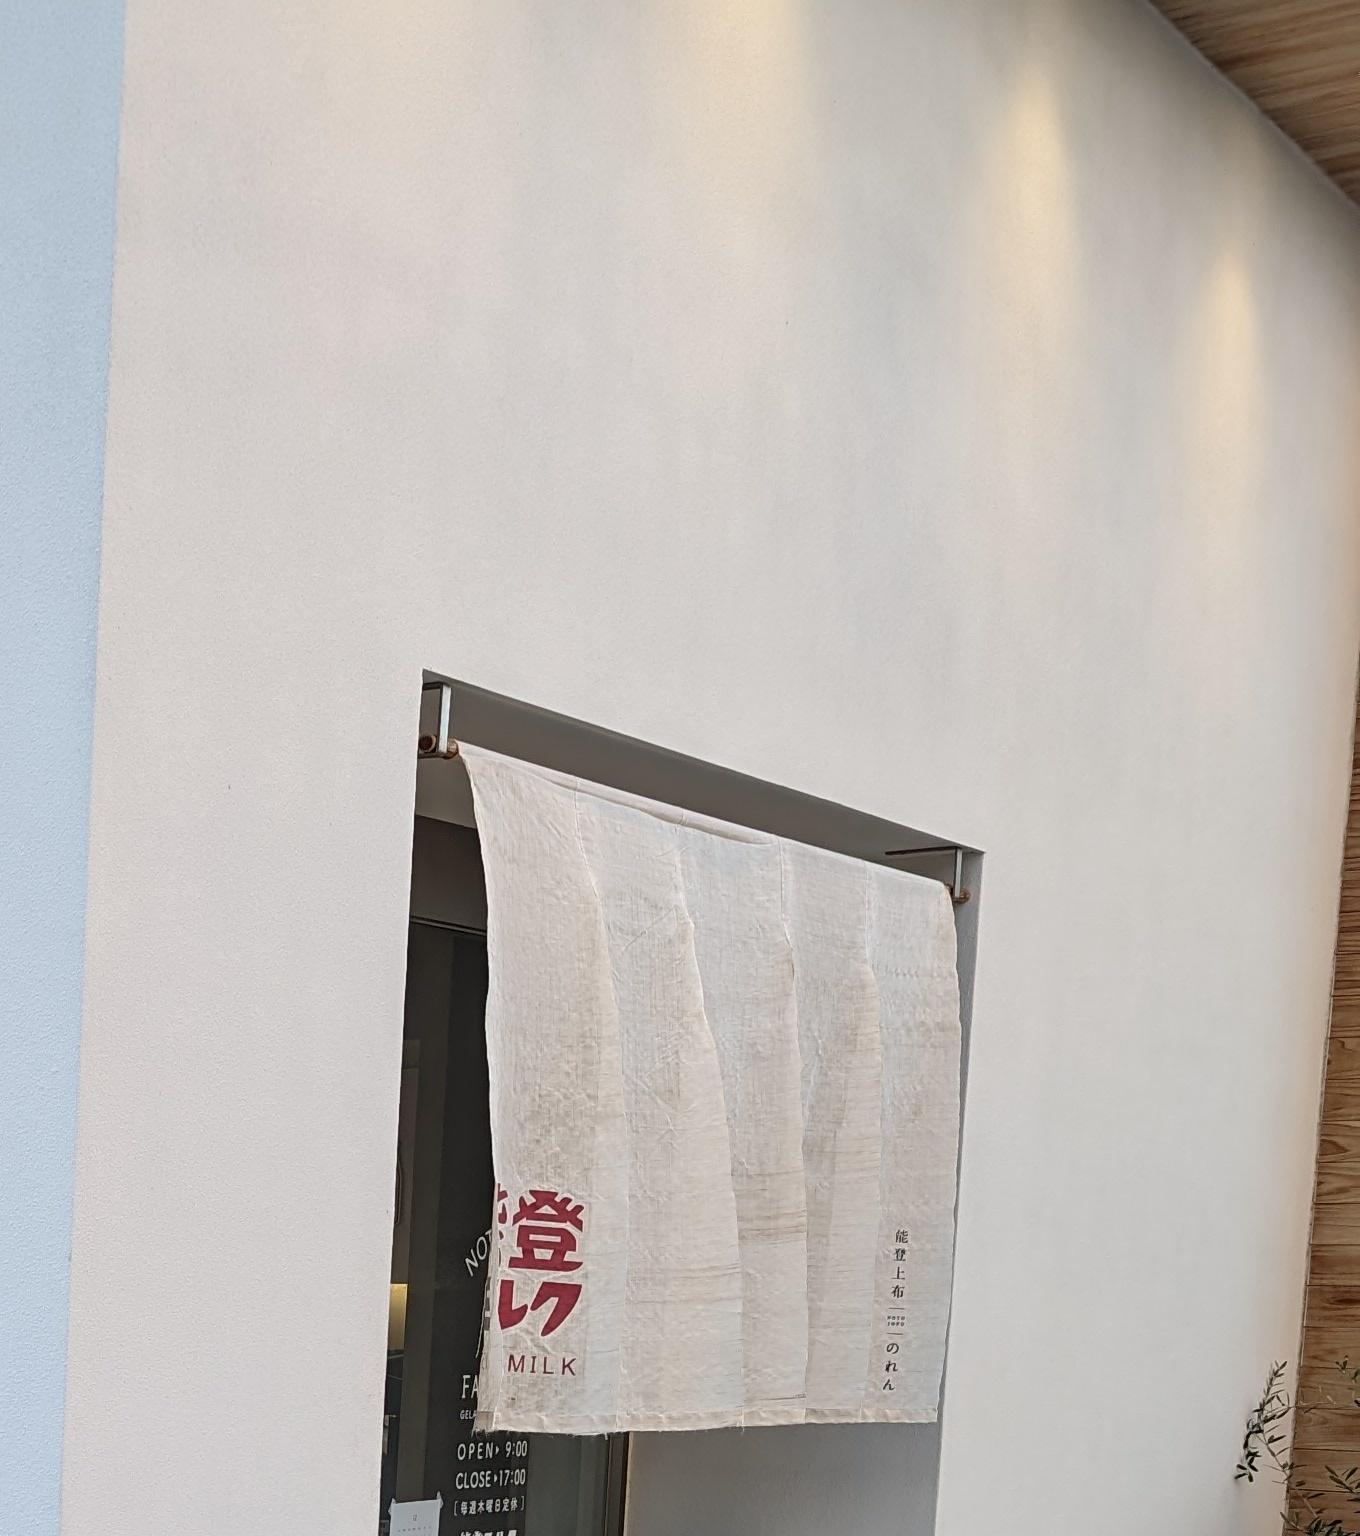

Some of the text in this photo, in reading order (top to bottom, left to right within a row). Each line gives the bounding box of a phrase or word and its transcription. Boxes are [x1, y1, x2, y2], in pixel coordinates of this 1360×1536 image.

[891, 1229, 909, 1299] 能登上布
[507, 1354, 578, 1376] MILK
[882, 1342, 900, 1391] のれん
[457, 1440, 528, 1461] OPEN 9:00
[455, 1468, 526, 1490] CLOSE 17:00
